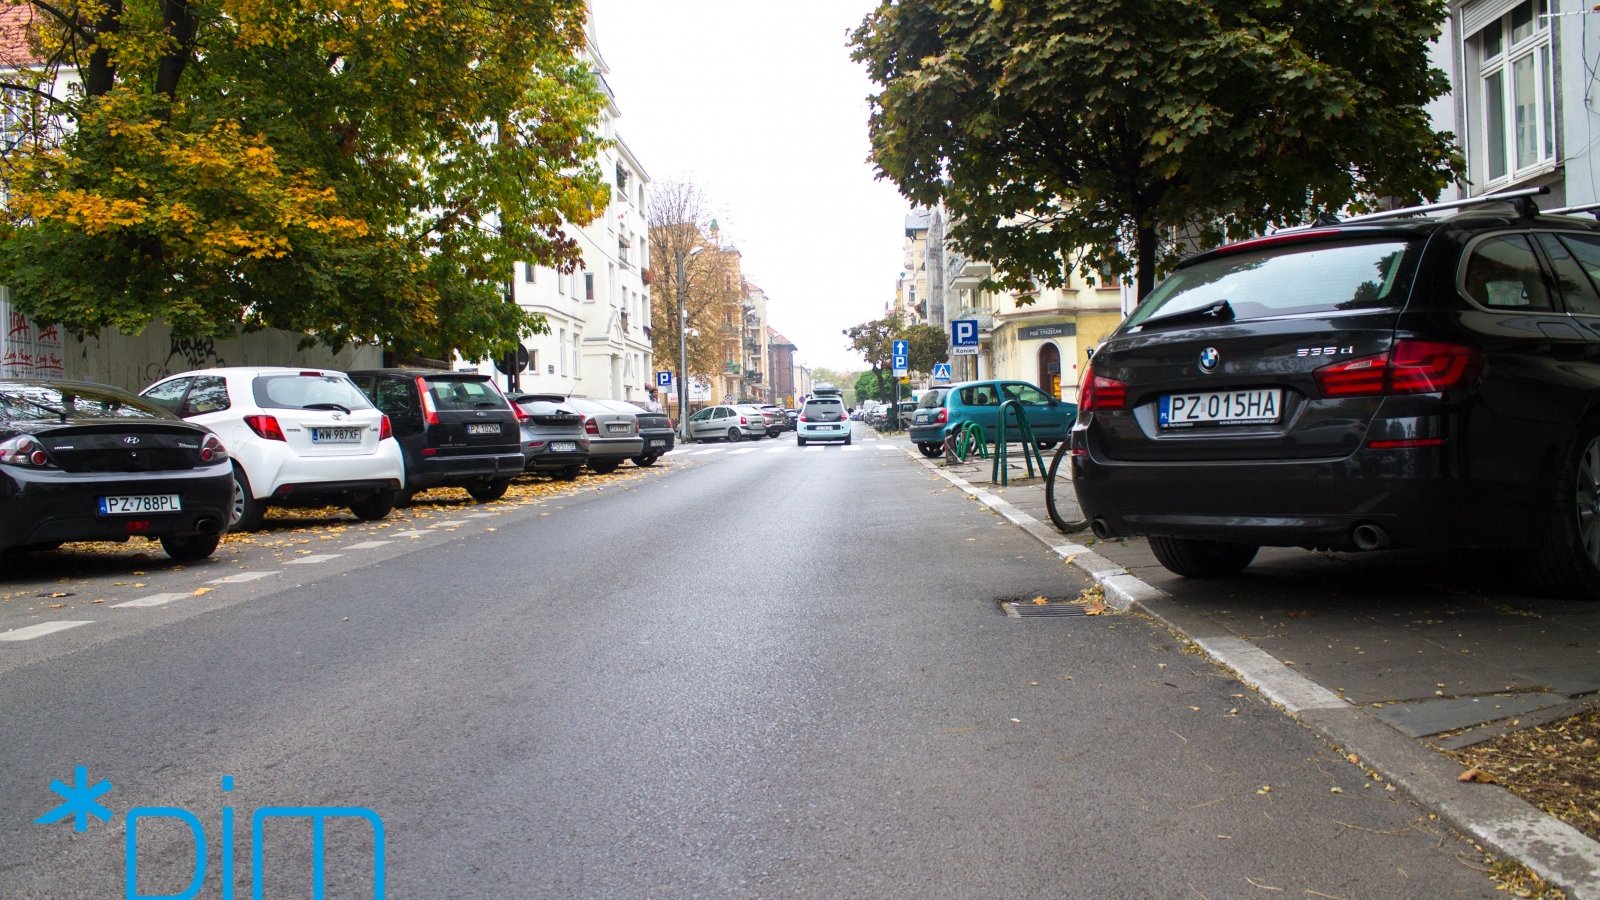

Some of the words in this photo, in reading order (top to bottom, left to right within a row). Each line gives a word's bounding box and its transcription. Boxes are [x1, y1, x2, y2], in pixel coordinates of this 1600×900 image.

[957, 322, 973, 344] P
[896, 356, 905, 368] P
[660, 373, 669, 385] P
[1171, 395, 1201, 421] PZ
[1207, 391, 1276, 419] 015HA
[1160, 412, 1168, 420] PL
[318, 429, 333, 440] WW
[334, 429, 359, 440] 987XF
[108, 497, 131, 512] PZ
[134, 496, 178, 512] 788PL
